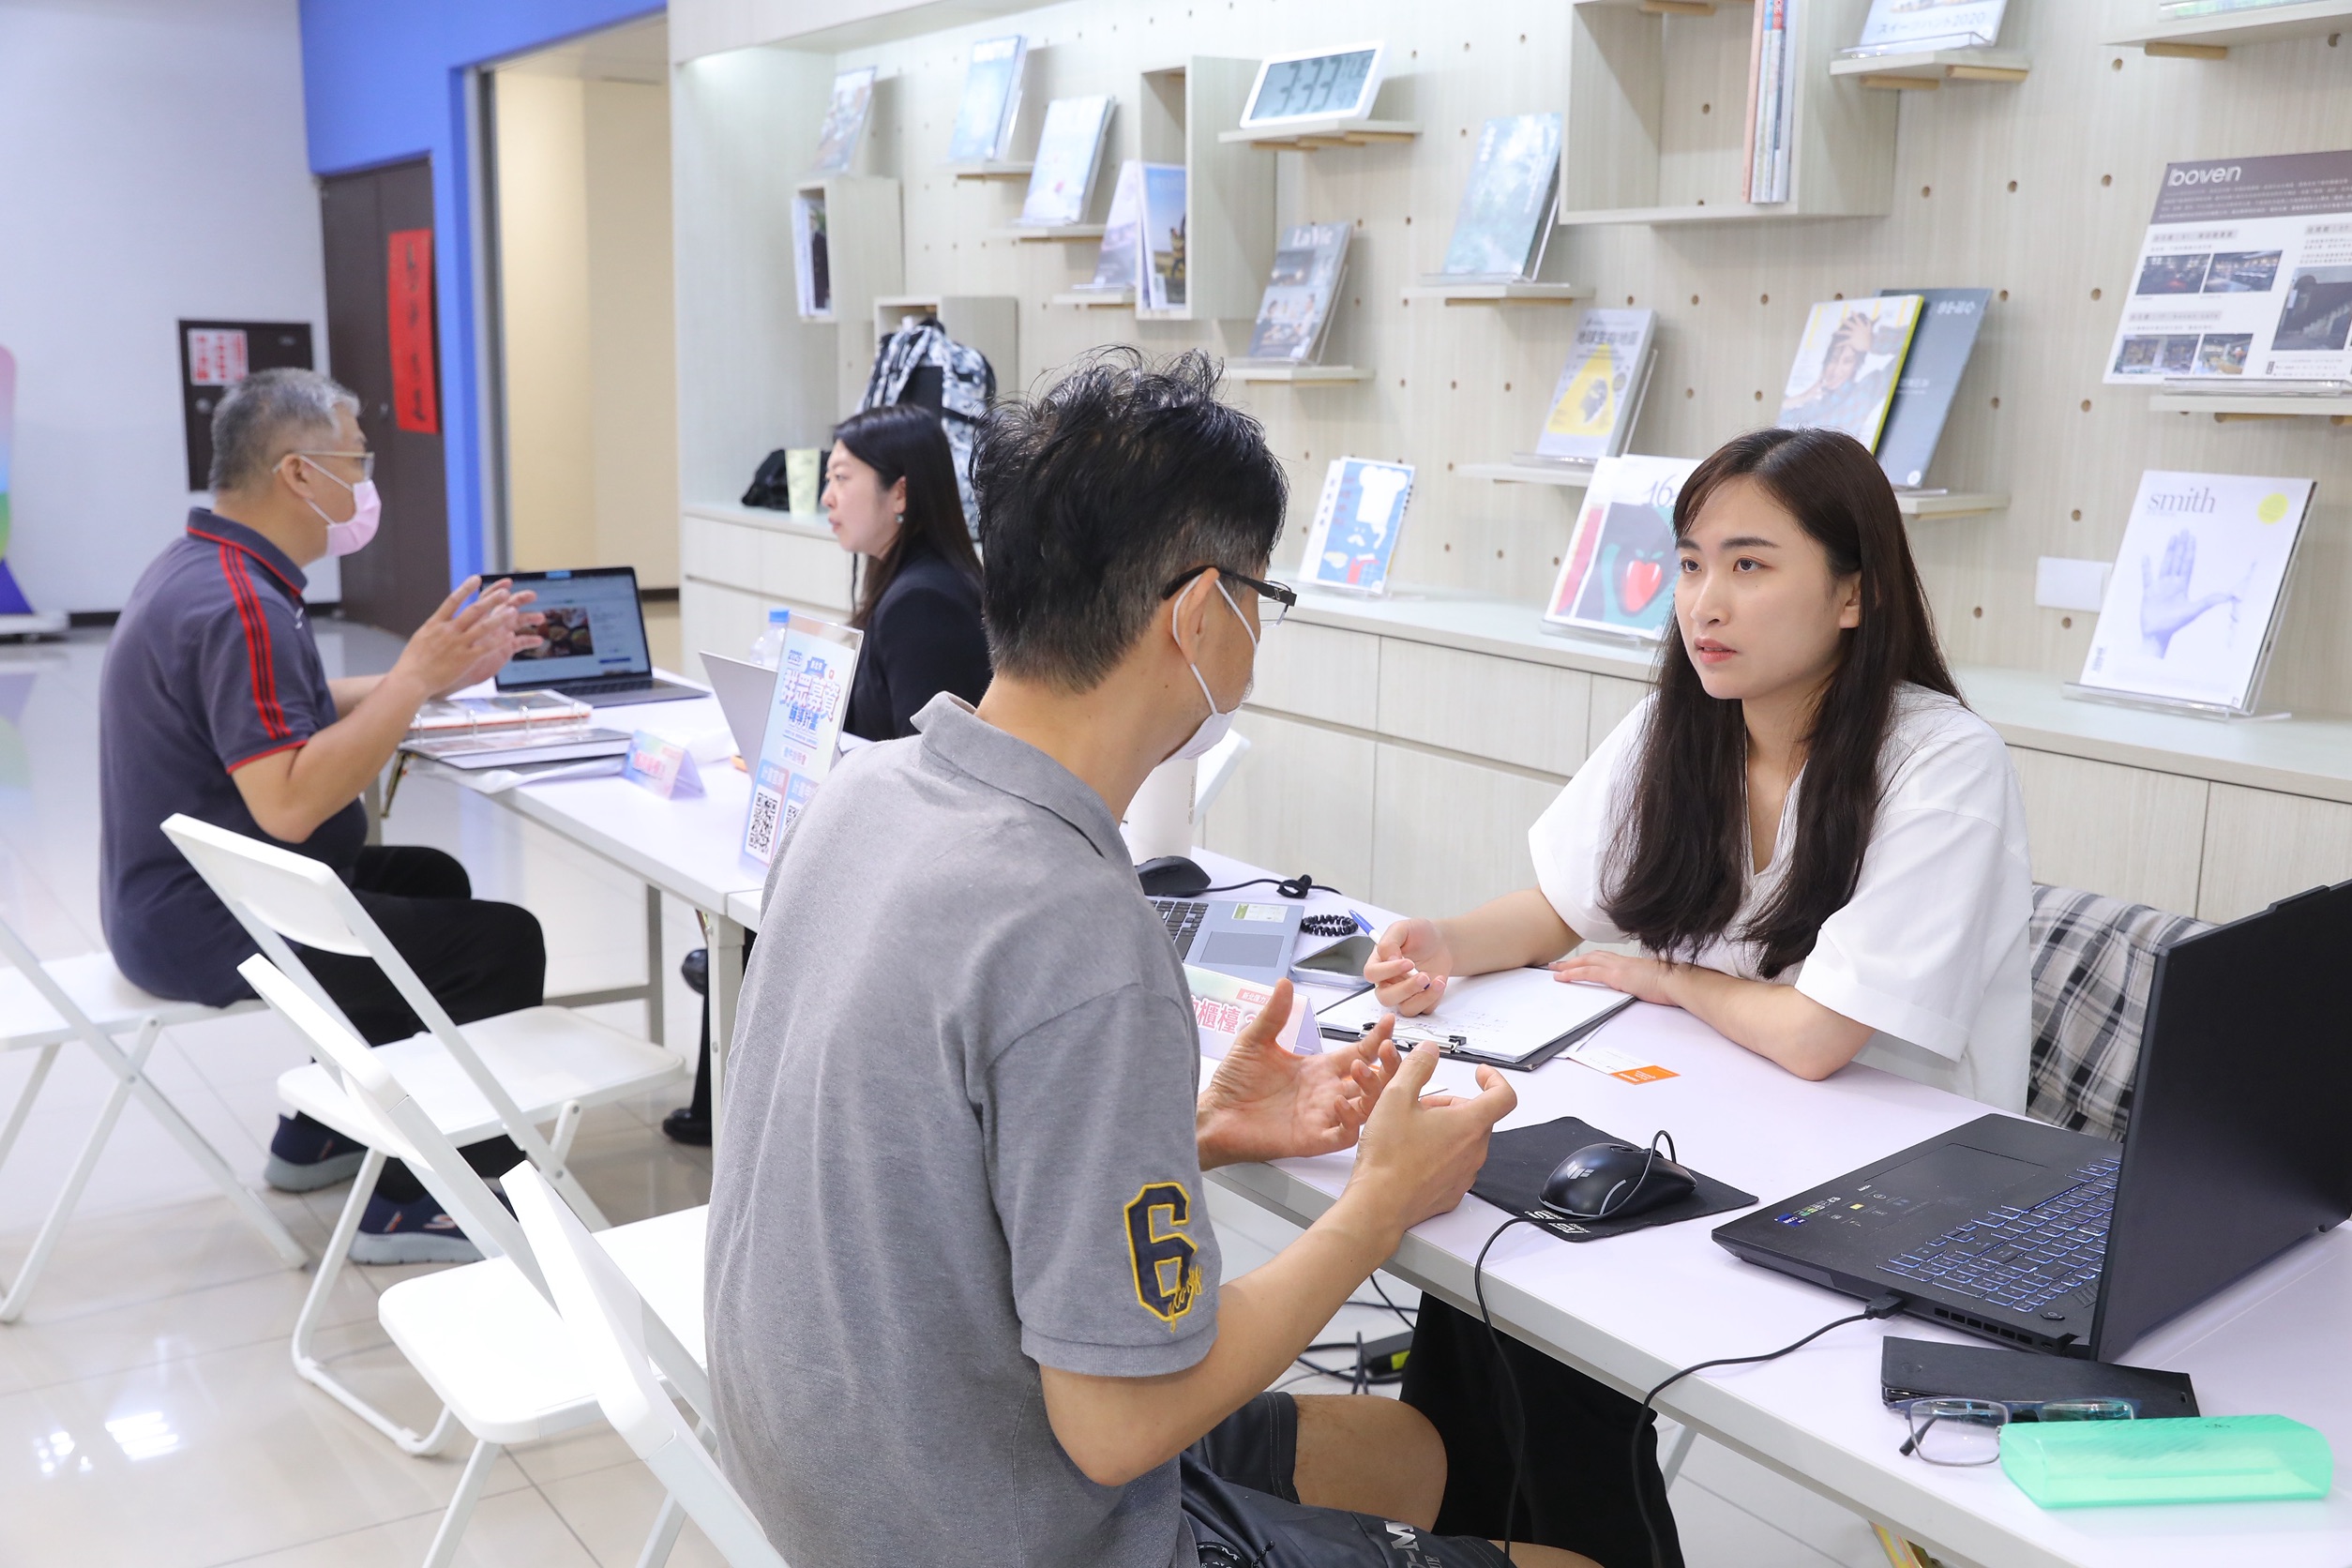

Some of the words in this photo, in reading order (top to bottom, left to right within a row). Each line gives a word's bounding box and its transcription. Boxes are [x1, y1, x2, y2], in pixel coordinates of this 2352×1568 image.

[2167, 165, 2242, 187] boven
[2147, 487, 2217, 514] smith
[1123, 1182, 1199, 1322] 6
